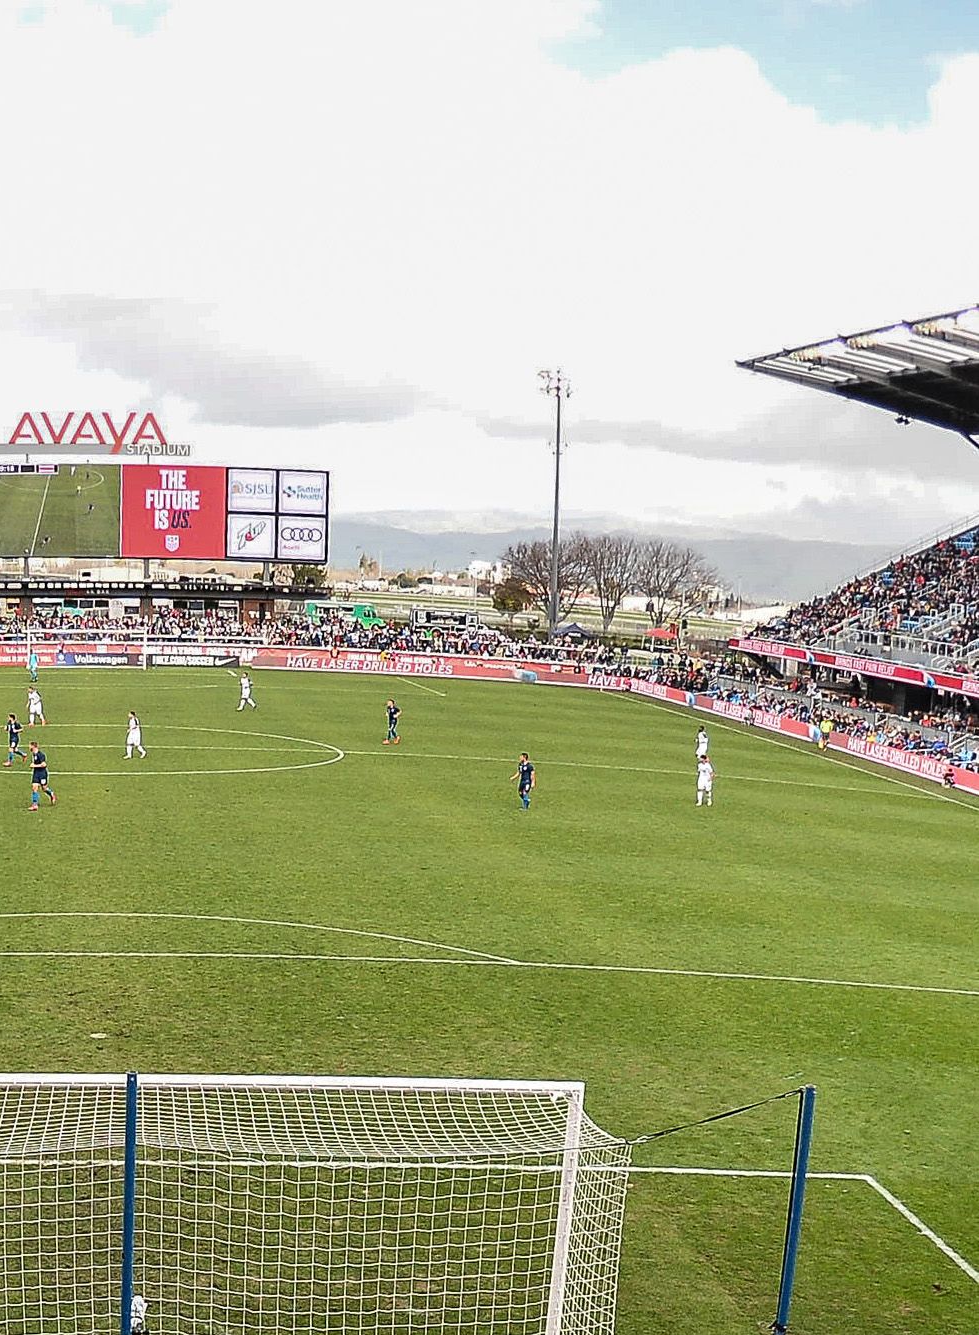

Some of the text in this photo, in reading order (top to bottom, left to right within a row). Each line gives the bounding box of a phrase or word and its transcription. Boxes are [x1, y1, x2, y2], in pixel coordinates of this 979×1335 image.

[8, 412, 167, 455] AVAYA
[126, 443, 191, 456] STADIUM
[159, 470, 187, 489] THE
[245, 483, 274, 495] SJSU
[145, 489, 200, 510] FUTURE
[154, 509, 192, 529] IS US.
[74, 654, 128, 667] Volkswagen
[286, 656, 319, 668] HAVE
[322, 659, 411, 673] LASER-DRILLED
[414, 662, 454, 675] HOLES
[587, 674, 617, 687] HAVE
[847, 737, 865, 754] HAVE
[866, 741, 920, 770] LASER-DRILLED
